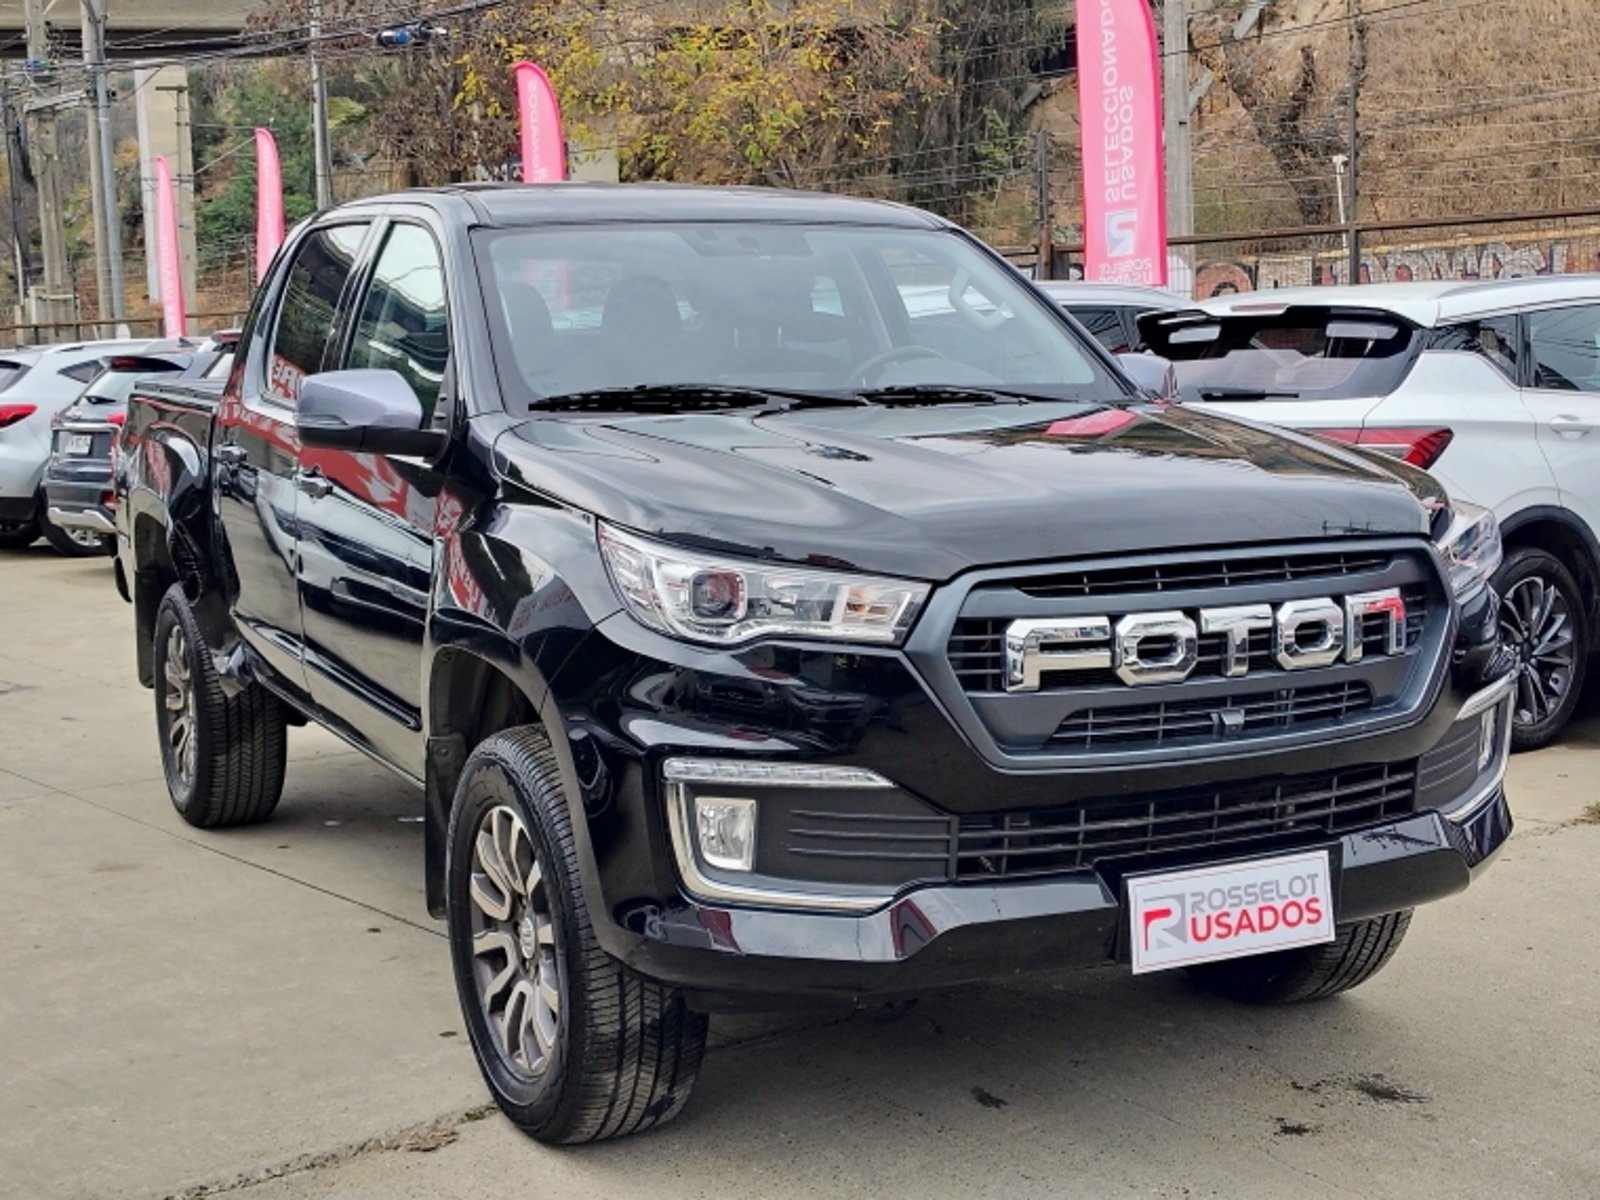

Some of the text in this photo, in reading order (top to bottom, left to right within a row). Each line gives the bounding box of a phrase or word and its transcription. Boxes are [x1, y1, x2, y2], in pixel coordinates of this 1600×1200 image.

[1003, 588, 1407, 692] FOTON
[1190, 873, 1319, 914] ROSSELOT
[1191, 897, 1323, 943] USADOS
